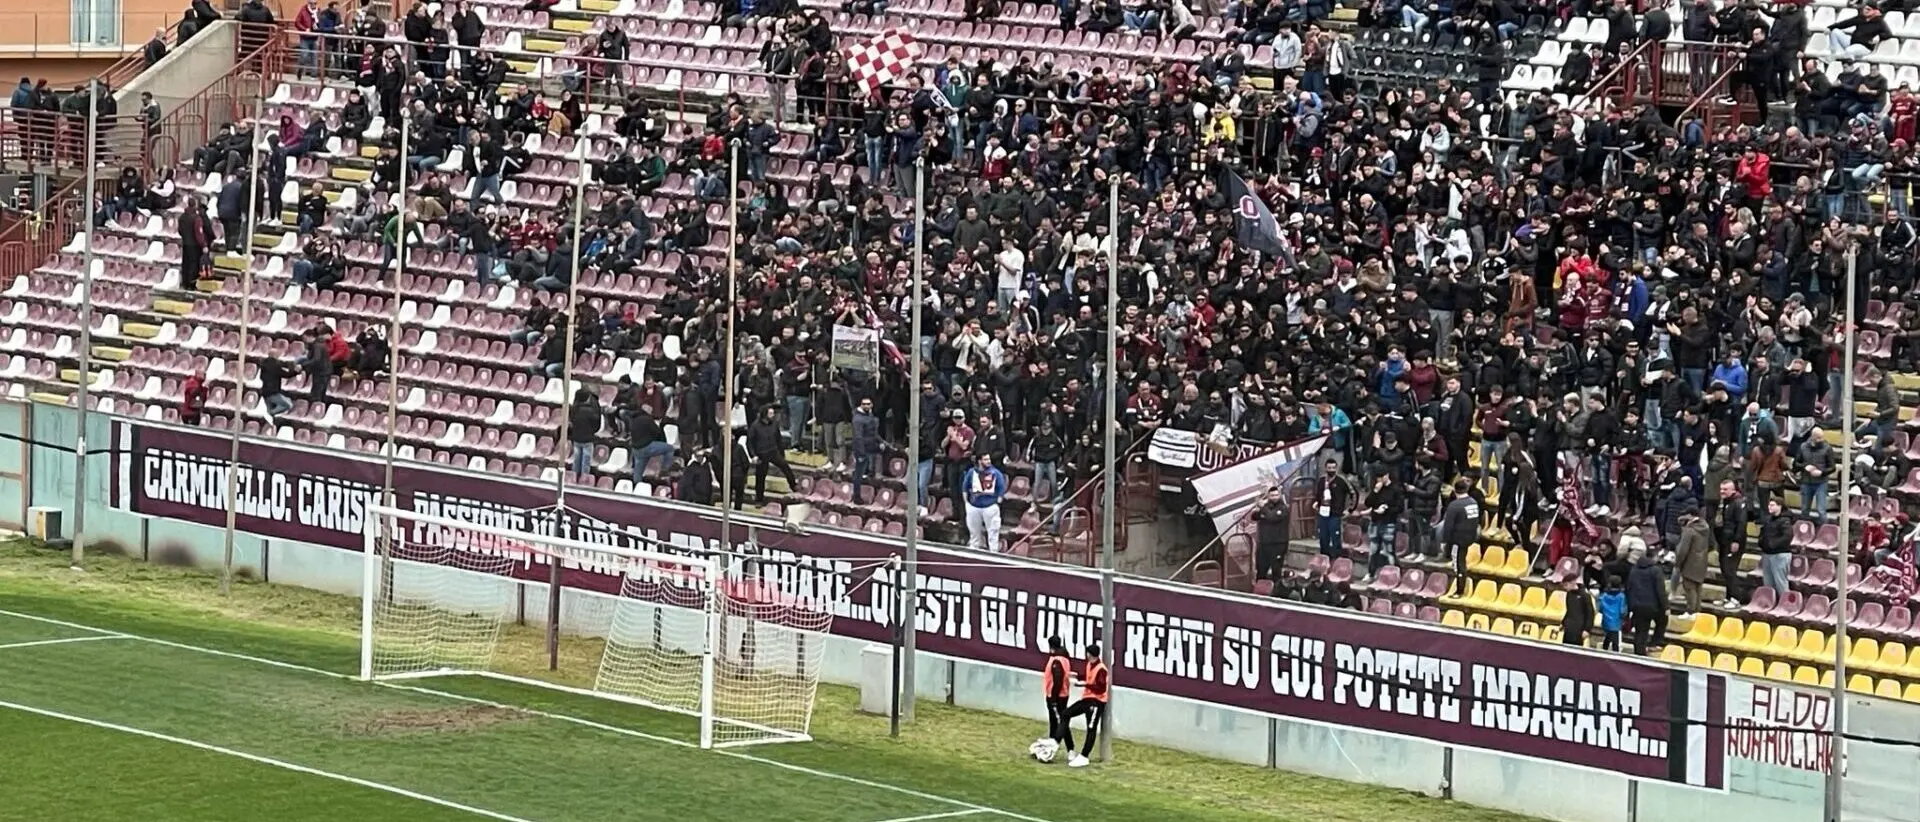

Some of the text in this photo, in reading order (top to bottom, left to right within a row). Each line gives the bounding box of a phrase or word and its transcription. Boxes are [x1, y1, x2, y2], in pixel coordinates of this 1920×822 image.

[144, 448, 292, 522] CARMINELLO:
[980, 585, 1027, 649] GLI
[1036, 594, 1116, 666] UNIC
[1124, 609, 1215, 682] REATI
[1222, 625, 1261, 689] SU
[1270, 634, 1325, 701] CUI
[1334, 643, 1461, 723] POTETE
[1471, 664, 1668, 758] INDAGARE...
[1752, 684, 1830, 730] ALDO
